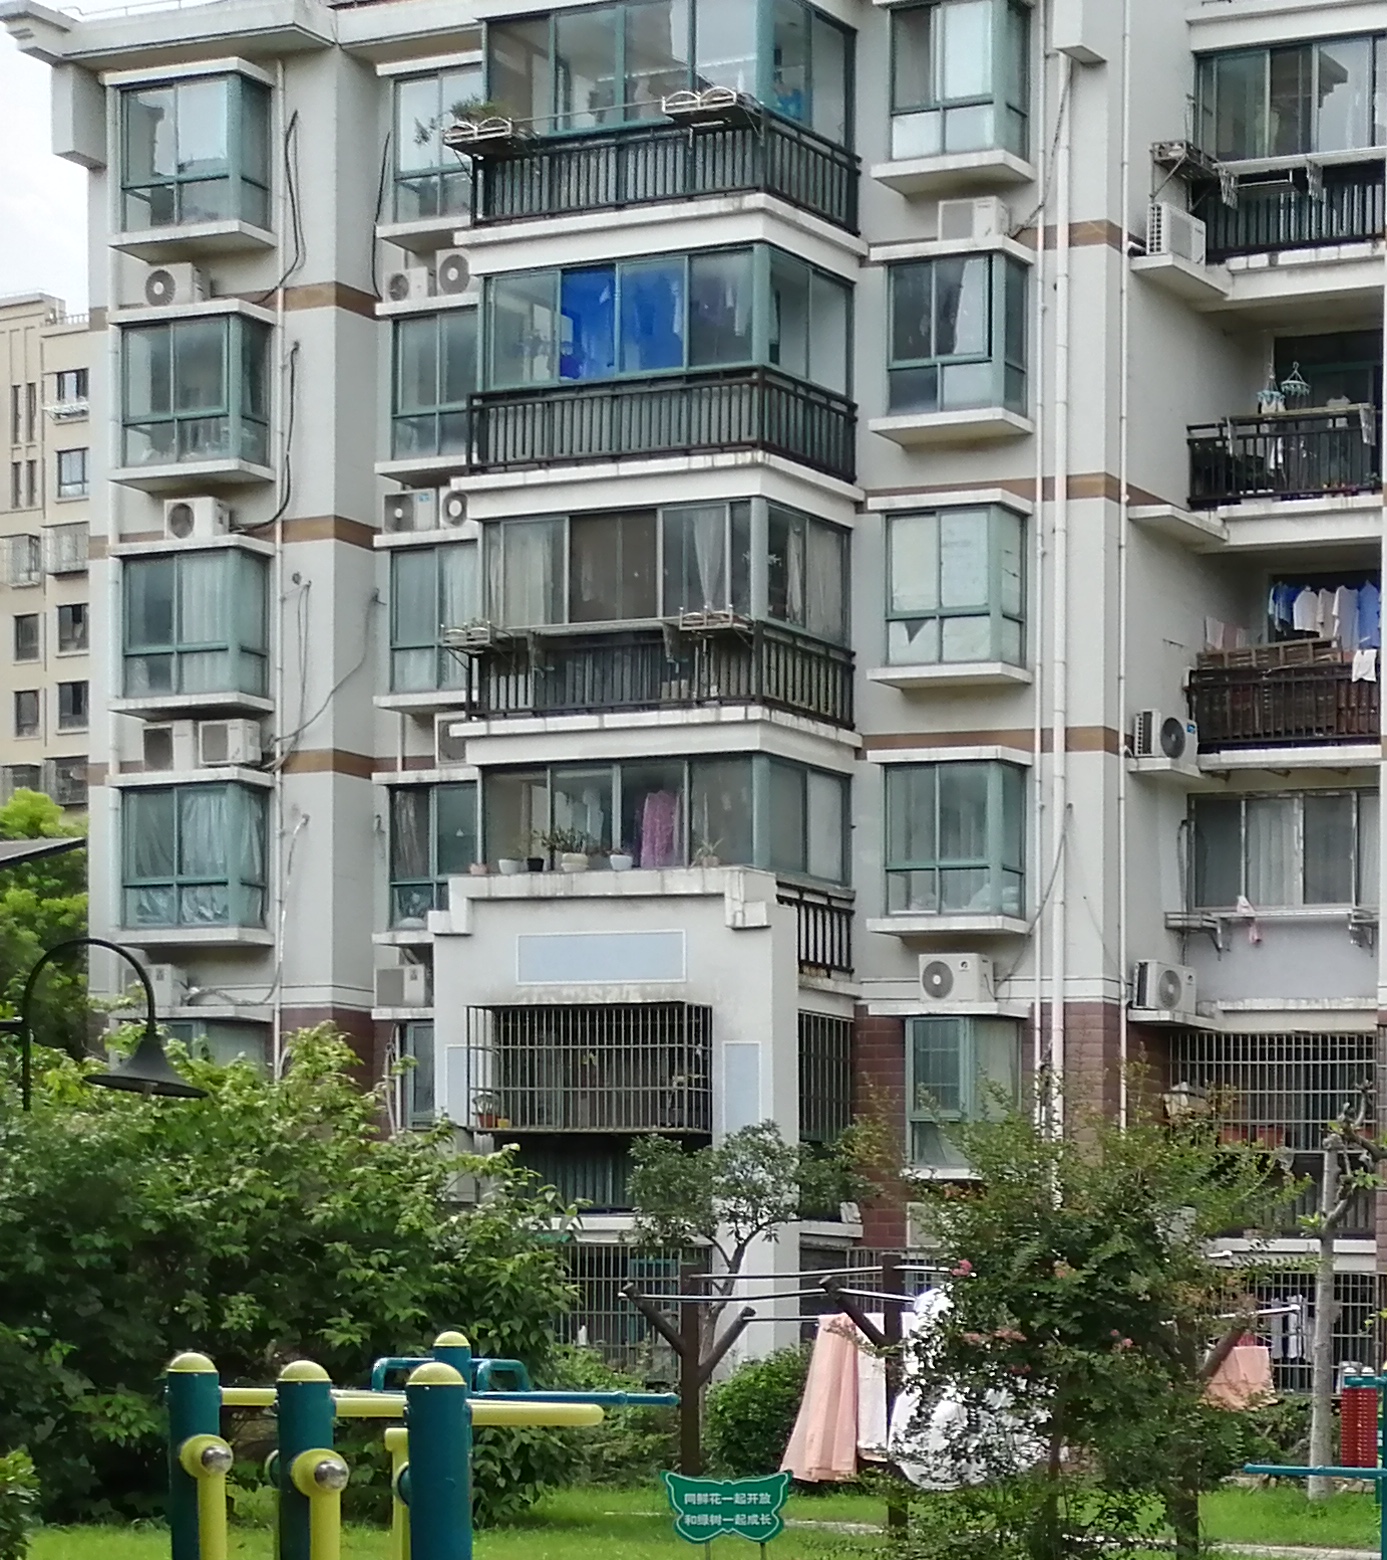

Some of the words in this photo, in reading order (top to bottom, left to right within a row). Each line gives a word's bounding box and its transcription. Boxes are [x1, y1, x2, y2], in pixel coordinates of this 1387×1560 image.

[684, 1514, 772, 1526] 和绿树一起成长
